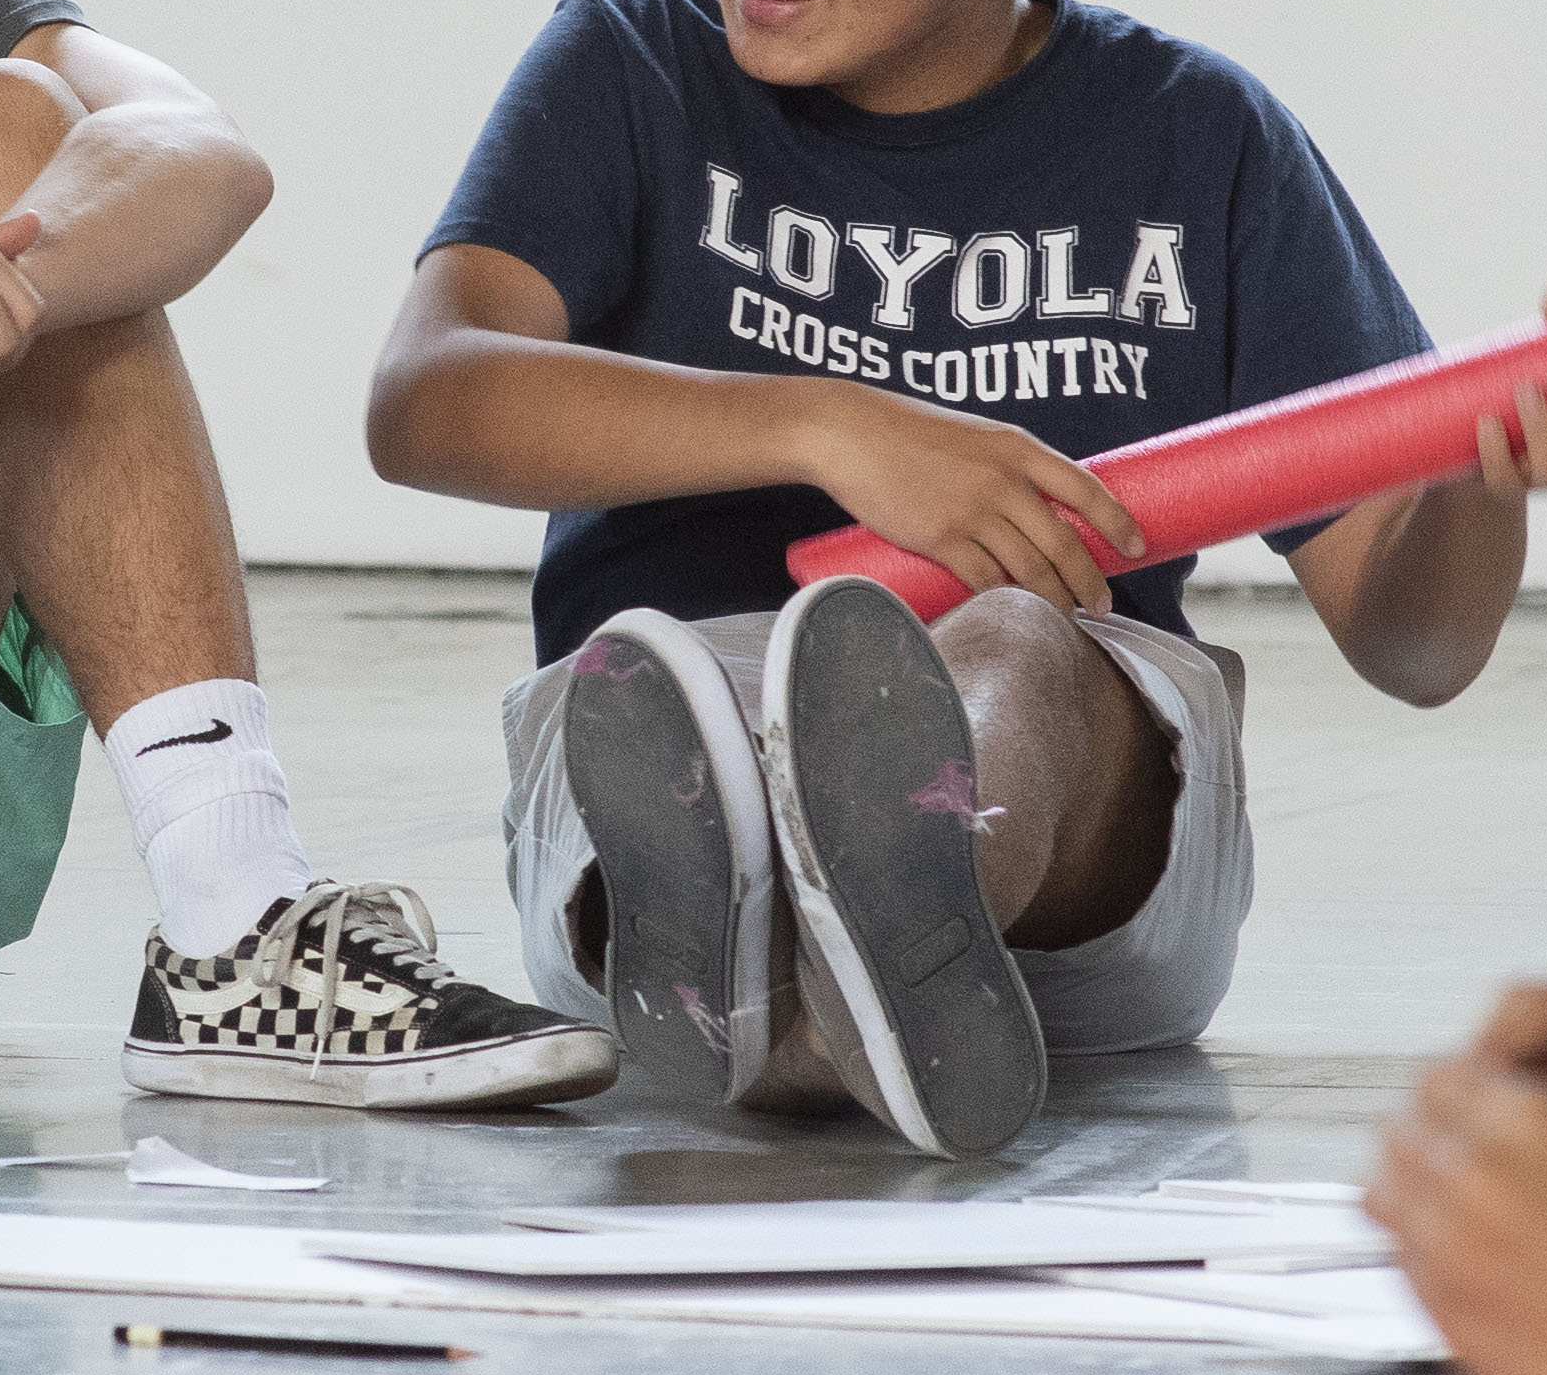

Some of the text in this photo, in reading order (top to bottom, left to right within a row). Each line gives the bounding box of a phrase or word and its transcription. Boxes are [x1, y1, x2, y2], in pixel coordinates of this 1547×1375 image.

[699, 161, 1197, 330] LOYOLA
[729, 285, 1149, 402] CROSS COUNTRY
